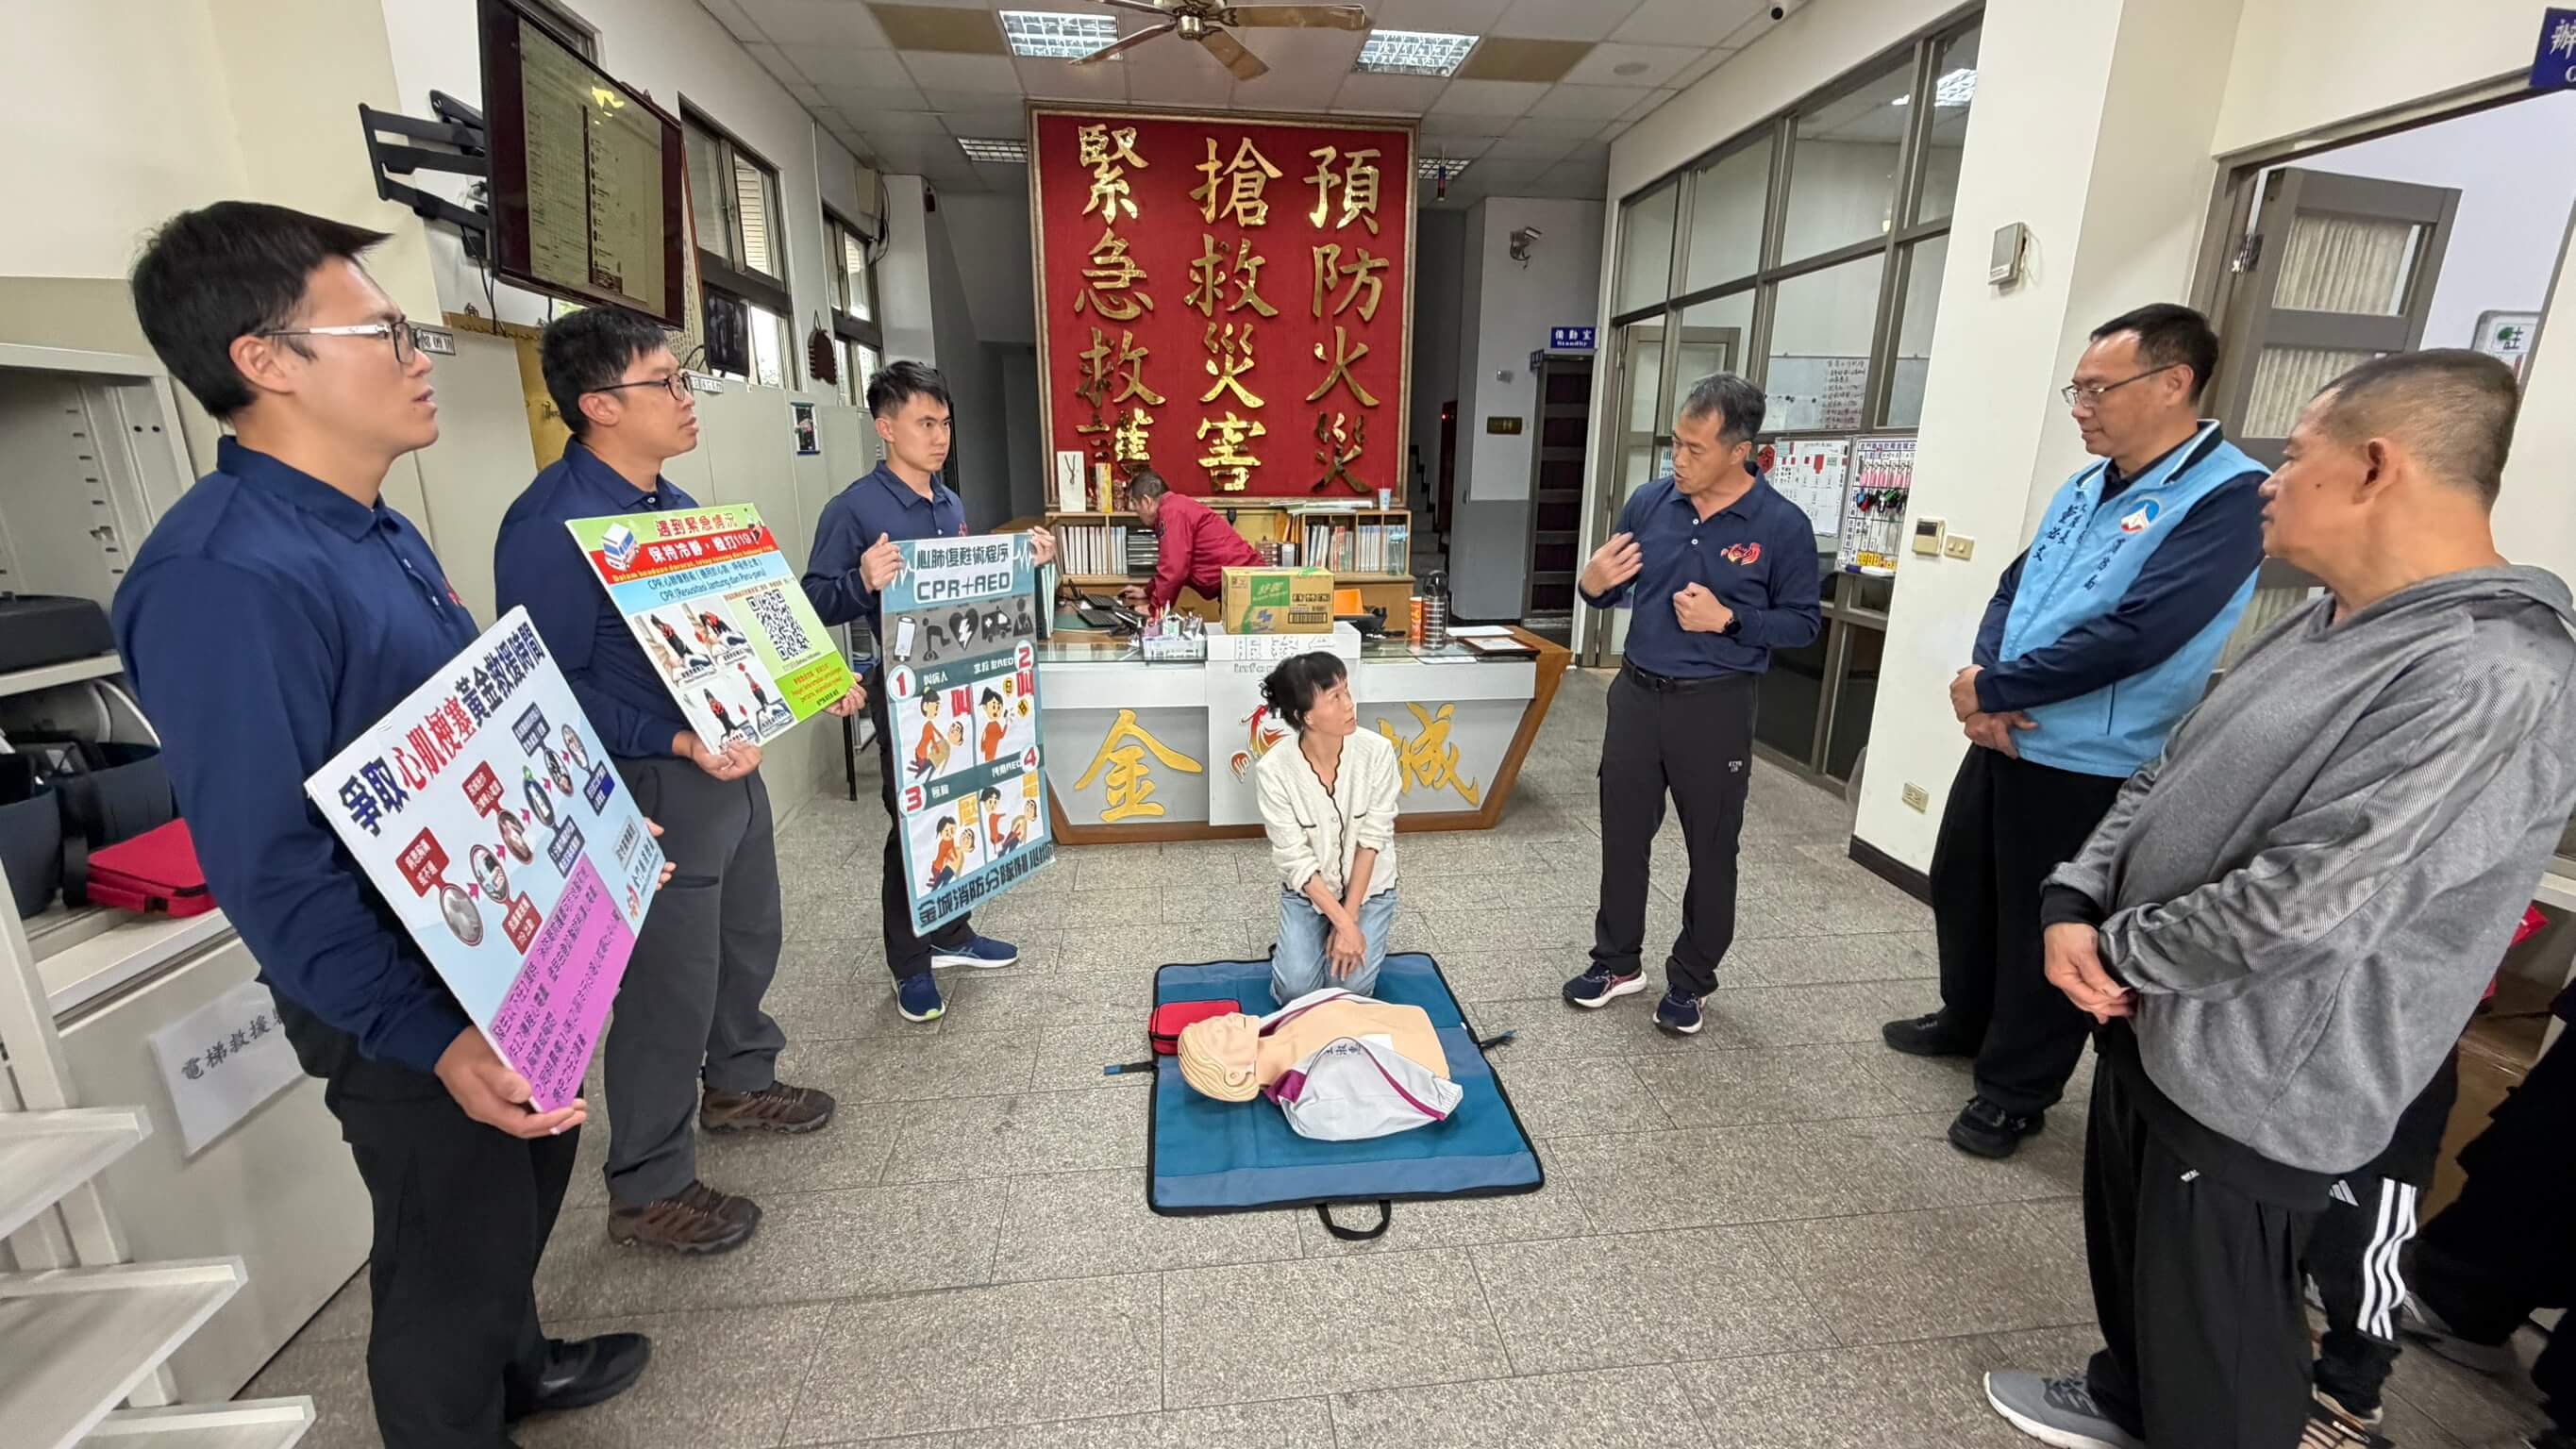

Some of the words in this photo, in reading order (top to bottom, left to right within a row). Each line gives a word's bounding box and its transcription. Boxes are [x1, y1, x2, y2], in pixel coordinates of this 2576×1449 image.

[1074, 124, 1166, 479] 緊急救護
[1183, 137, 1284, 491] 搶救災害
[1303, 145, 1390, 492] 預防火災
[656, 512, 738, 538] 遇到緊急情況
[917, 543, 1009, 569] 心肺復甦術程序
[917, 573, 1011, 600] CPR+AED
[1018, 646, 1031, 668] 2
[896, 672, 907, 696] 1
[1016, 670, 1034, 697] 叫
[950, 685, 971, 717] 叫
[339, 622, 545, 837] 爭取心肌梗塞黃金救援時間
[1024, 747, 1035, 766] 4
[1074, 708, 1203, 823] 金
[1377, 702, 1480, 807] 城
[905, 786, 922, 811] 3
